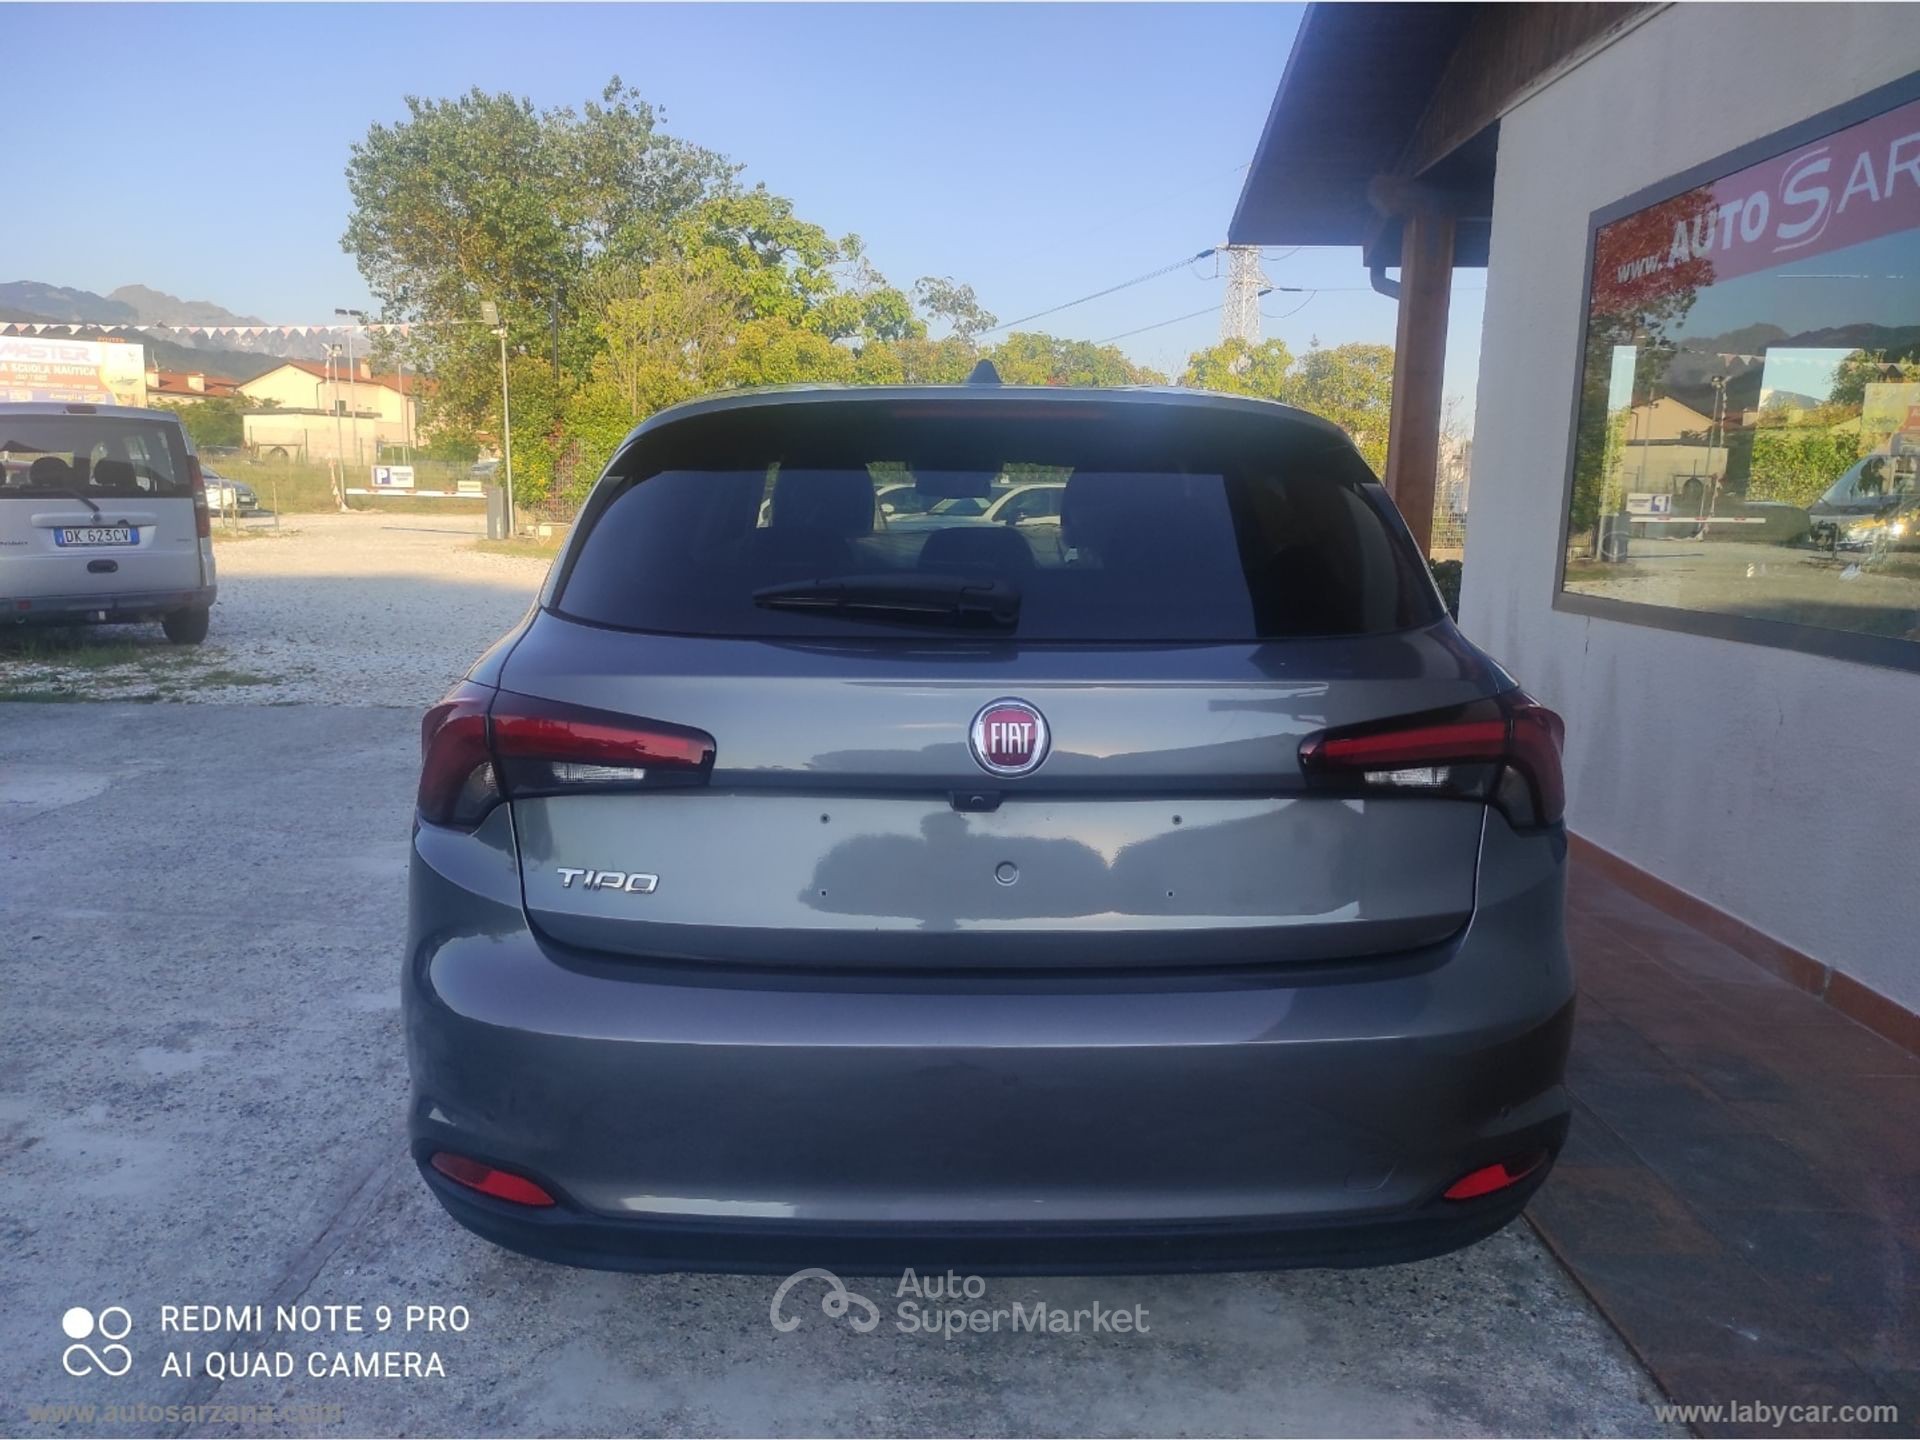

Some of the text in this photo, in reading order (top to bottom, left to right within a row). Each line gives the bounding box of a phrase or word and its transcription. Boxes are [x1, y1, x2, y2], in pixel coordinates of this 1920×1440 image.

[12, 363, 51, 375] SCUOLA
[53, 365, 97, 377] NAUTICA
[64, 528, 130, 543] DK 623CV
[990, 722, 1032, 754] FIAT
[557, 867, 660, 894] TIPO
